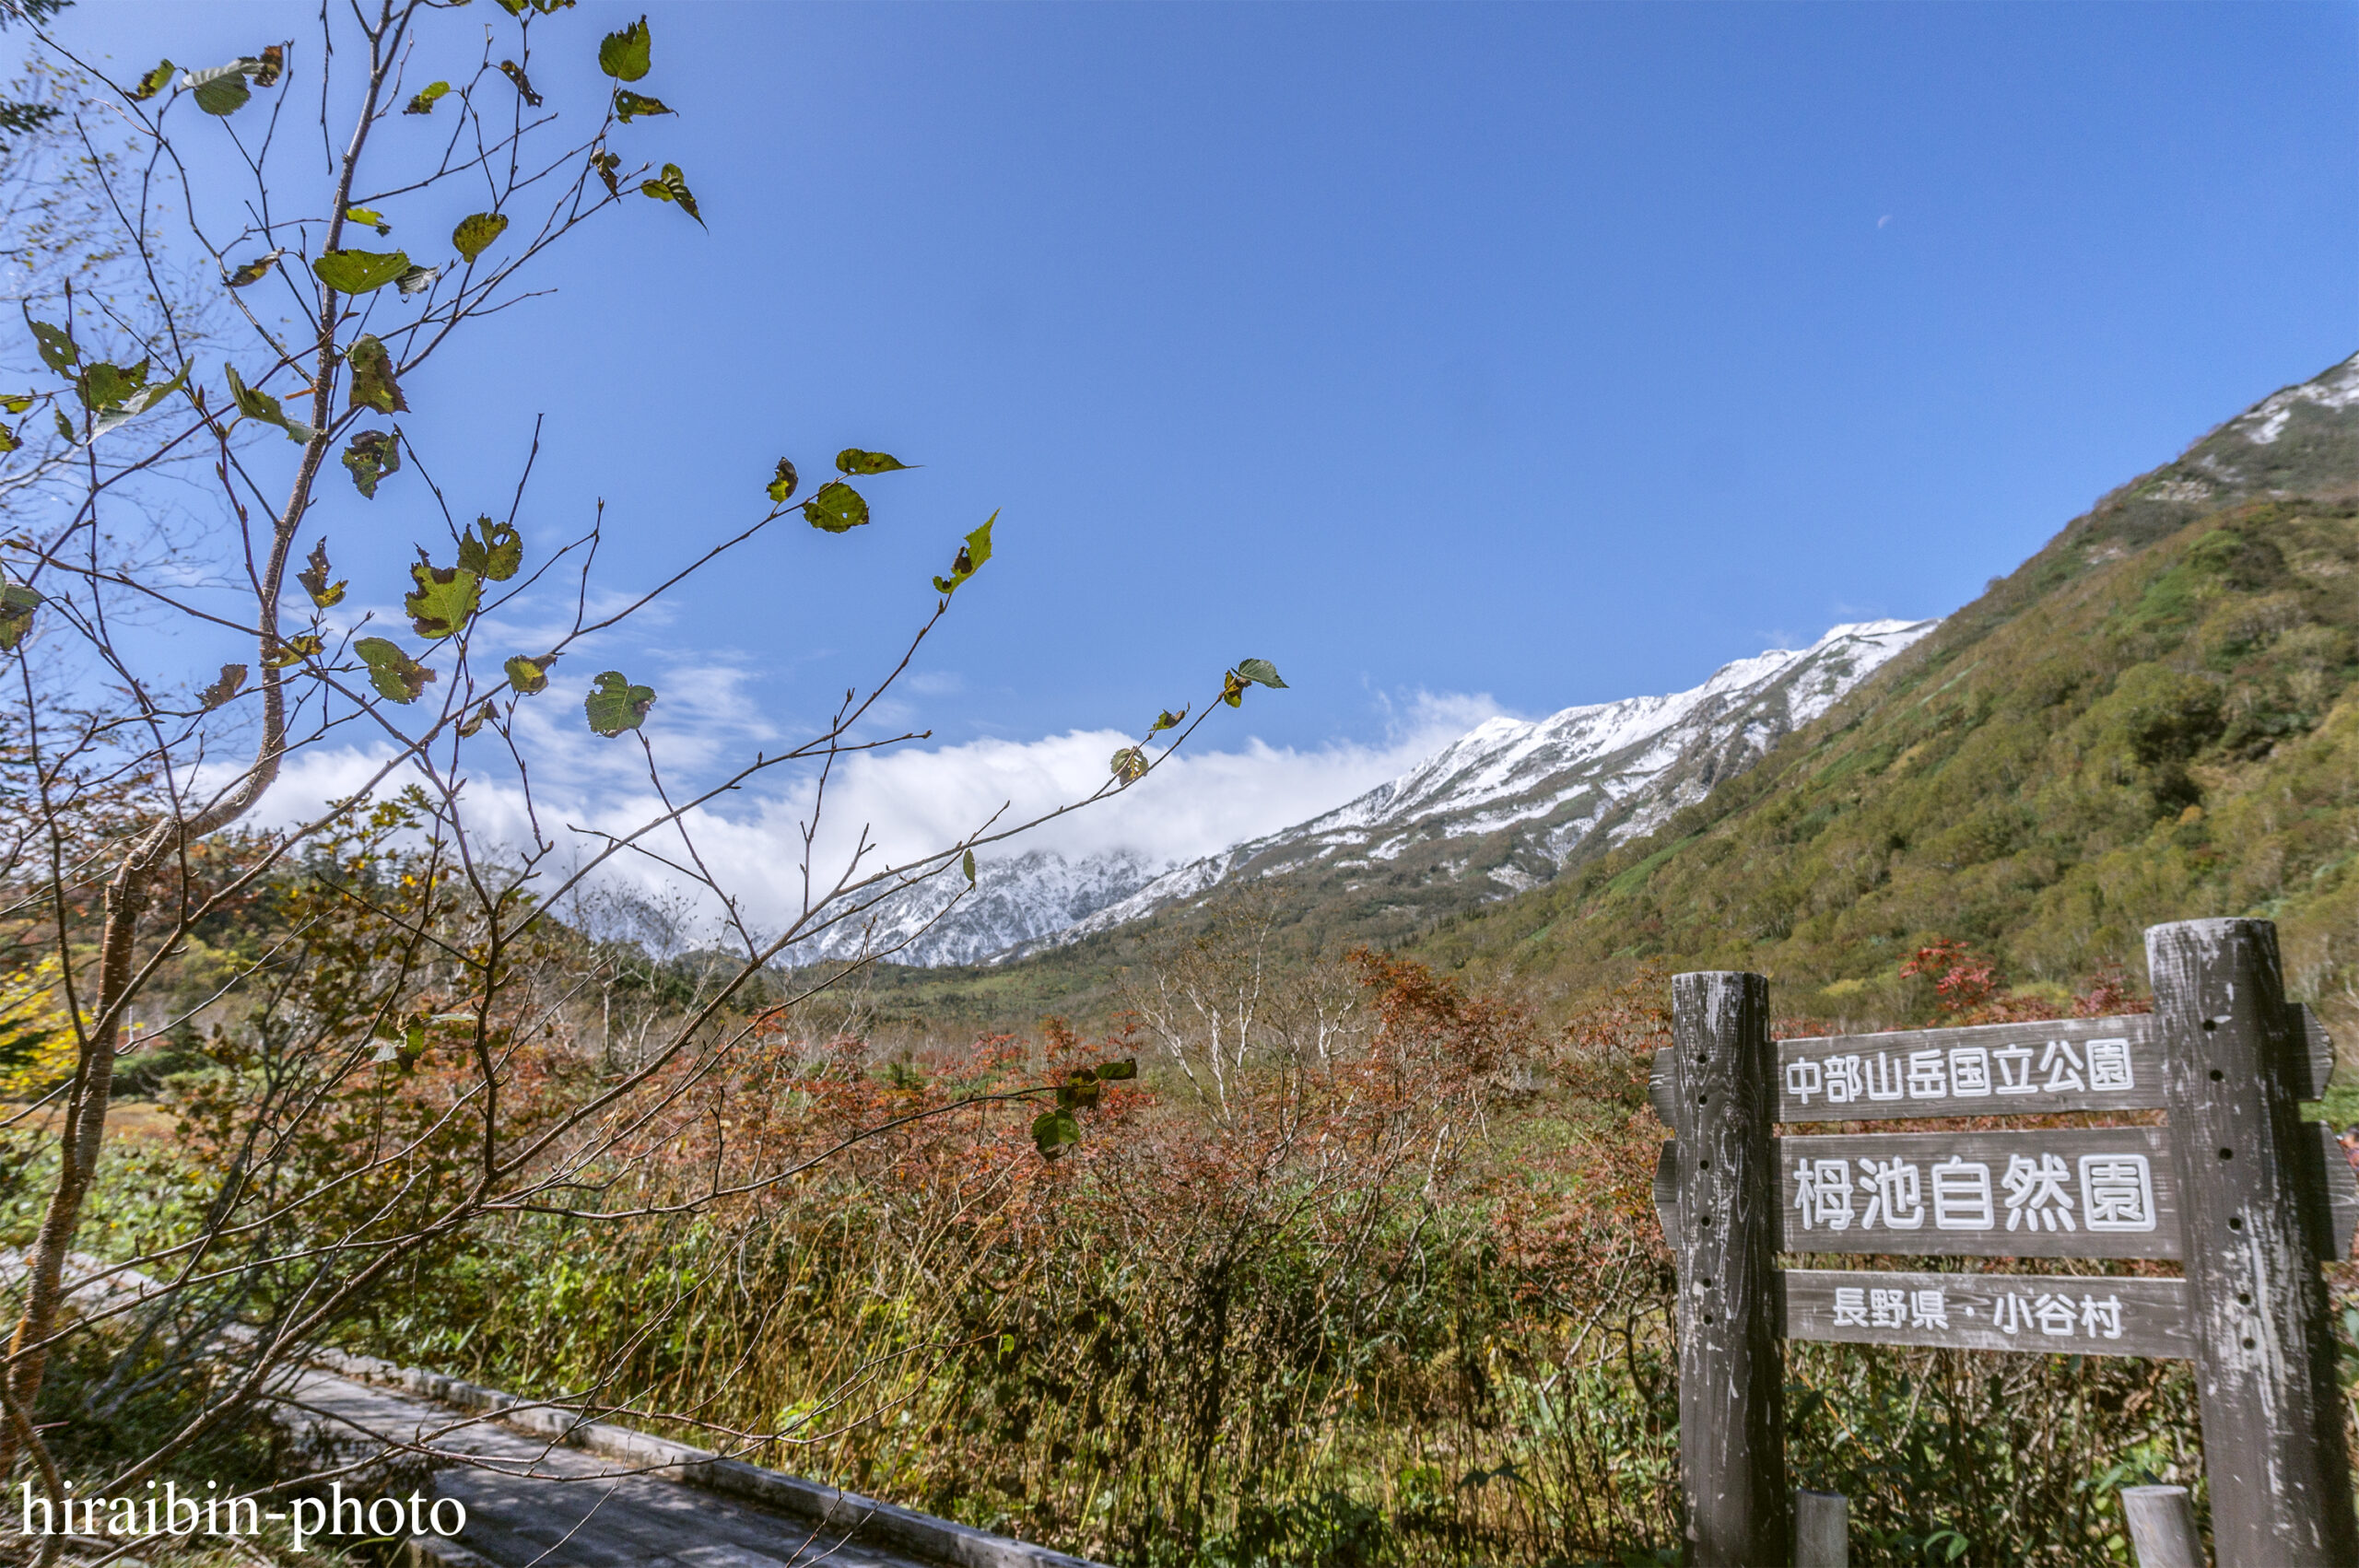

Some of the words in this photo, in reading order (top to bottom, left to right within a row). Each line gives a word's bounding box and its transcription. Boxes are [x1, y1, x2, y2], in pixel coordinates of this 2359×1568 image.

[1786, 1038, 2134, 1105] 中部山岳国立公園
[1793, 1153, 2156, 1233] 栂池自然園
